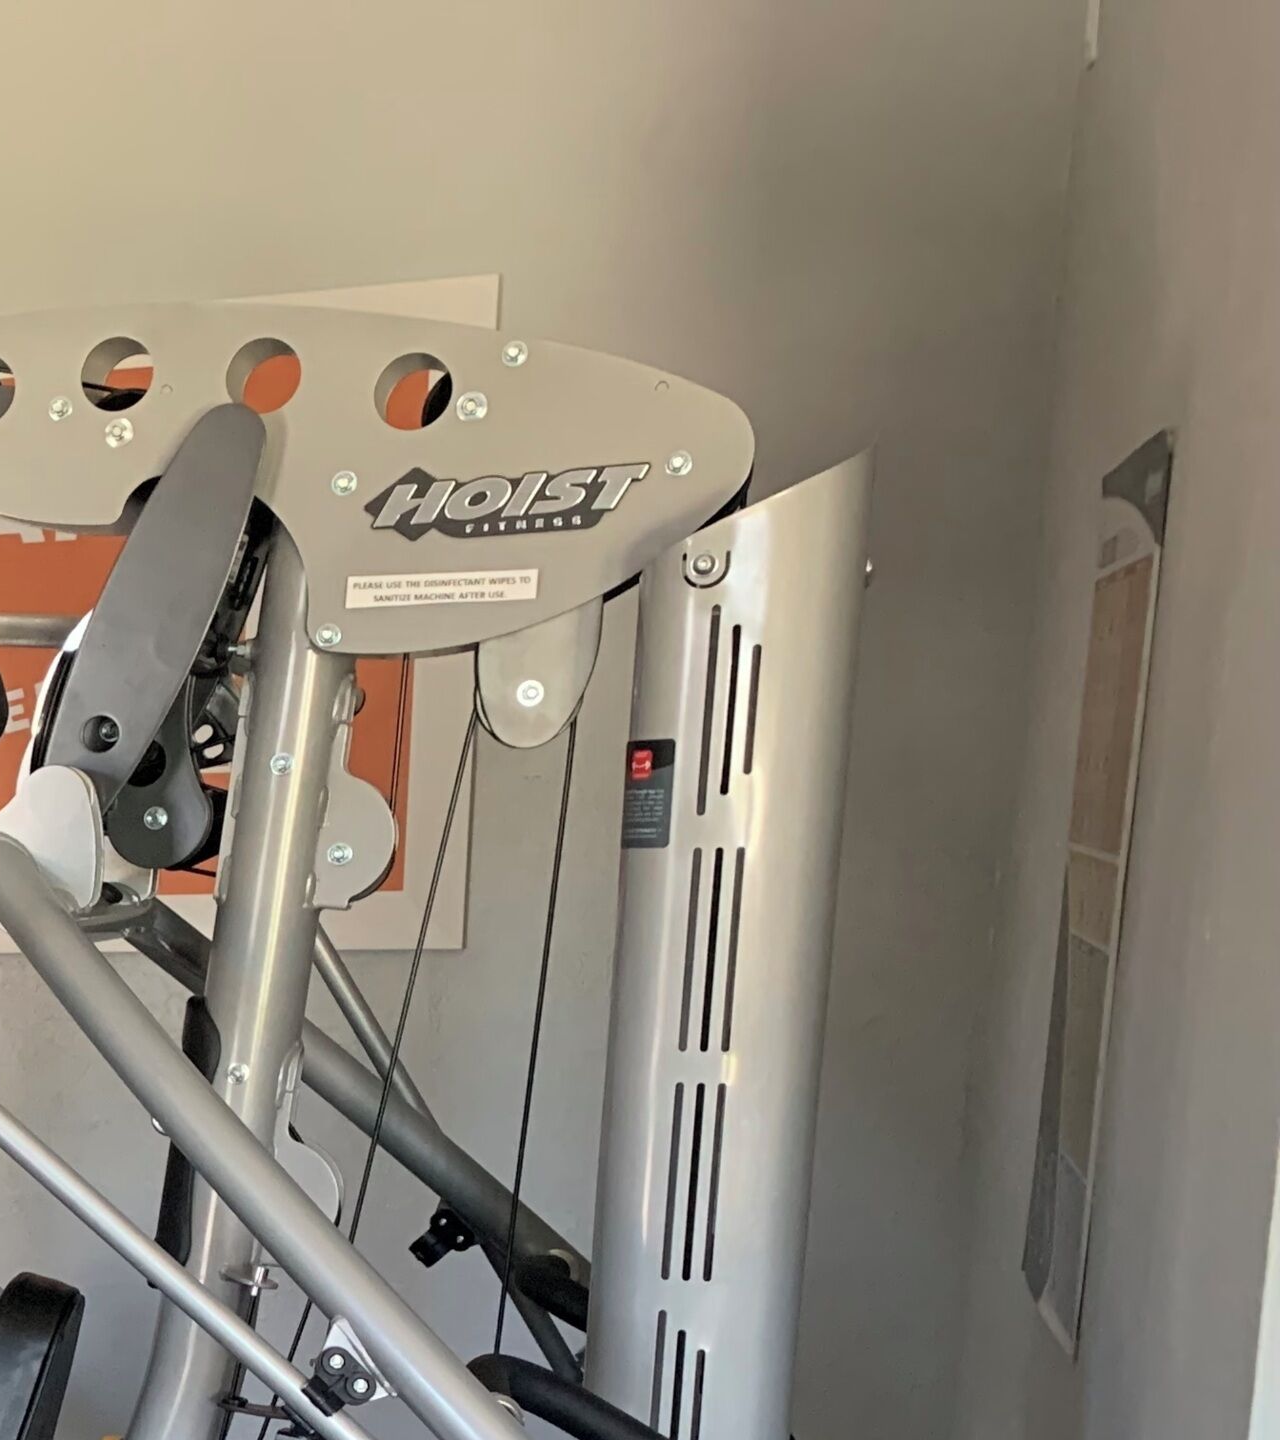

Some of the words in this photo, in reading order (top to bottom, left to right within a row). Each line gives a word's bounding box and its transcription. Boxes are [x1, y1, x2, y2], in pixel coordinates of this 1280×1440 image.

[373, 463, 650, 528] HOIST
[465, 515, 582, 534] FITNESS
[353, 581, 383, 590] PLEASE
[386, 580, 402, 589] USE
[406, 580, 421, 588] THE
[424, 578, 486, 588] DISINFECTANT
[489, 577, 516, 586] WIPES
[519, 576, 531, 584] TO
[373, 594, 411, 602] SANITIZE
[414, 592, 455, 601] MACHINE
[459, 591, 485, 600] AFTER
